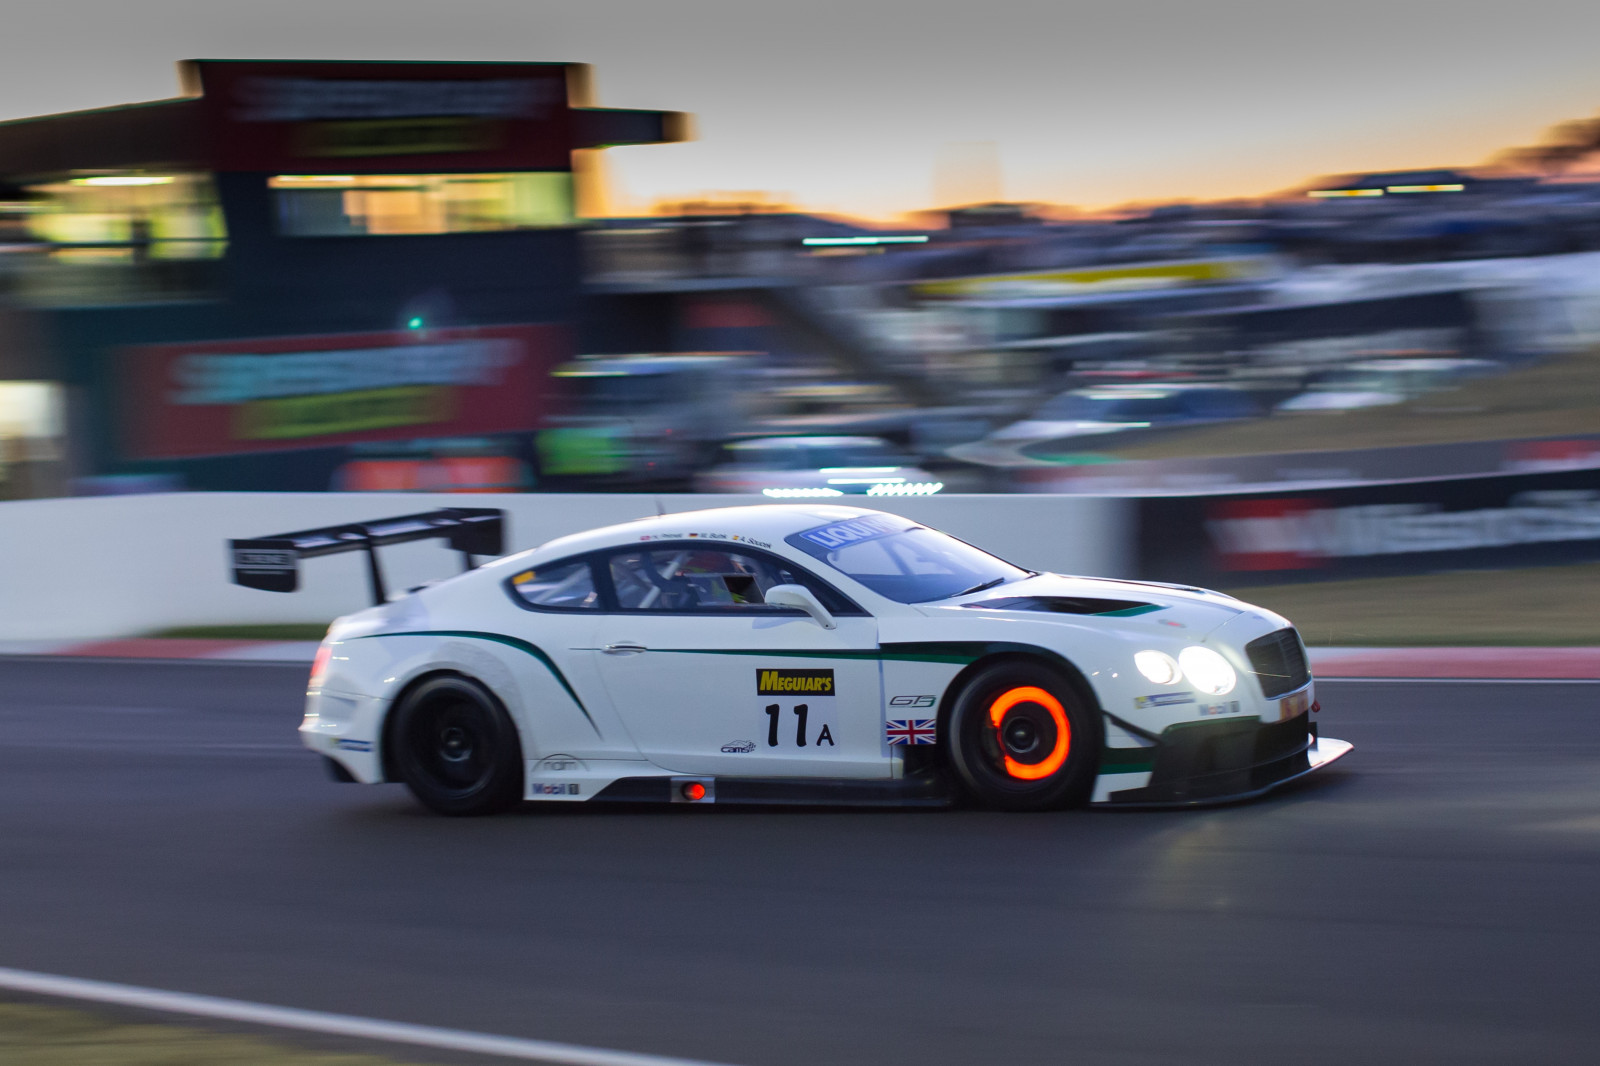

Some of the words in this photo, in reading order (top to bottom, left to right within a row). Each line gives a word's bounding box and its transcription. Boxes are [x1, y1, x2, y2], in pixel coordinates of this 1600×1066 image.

[807, 519, 880, 547] LIQUI
[760, 671, 832, 691] MEGUIAR'S
[532, 783, 566, 795] Mobil
